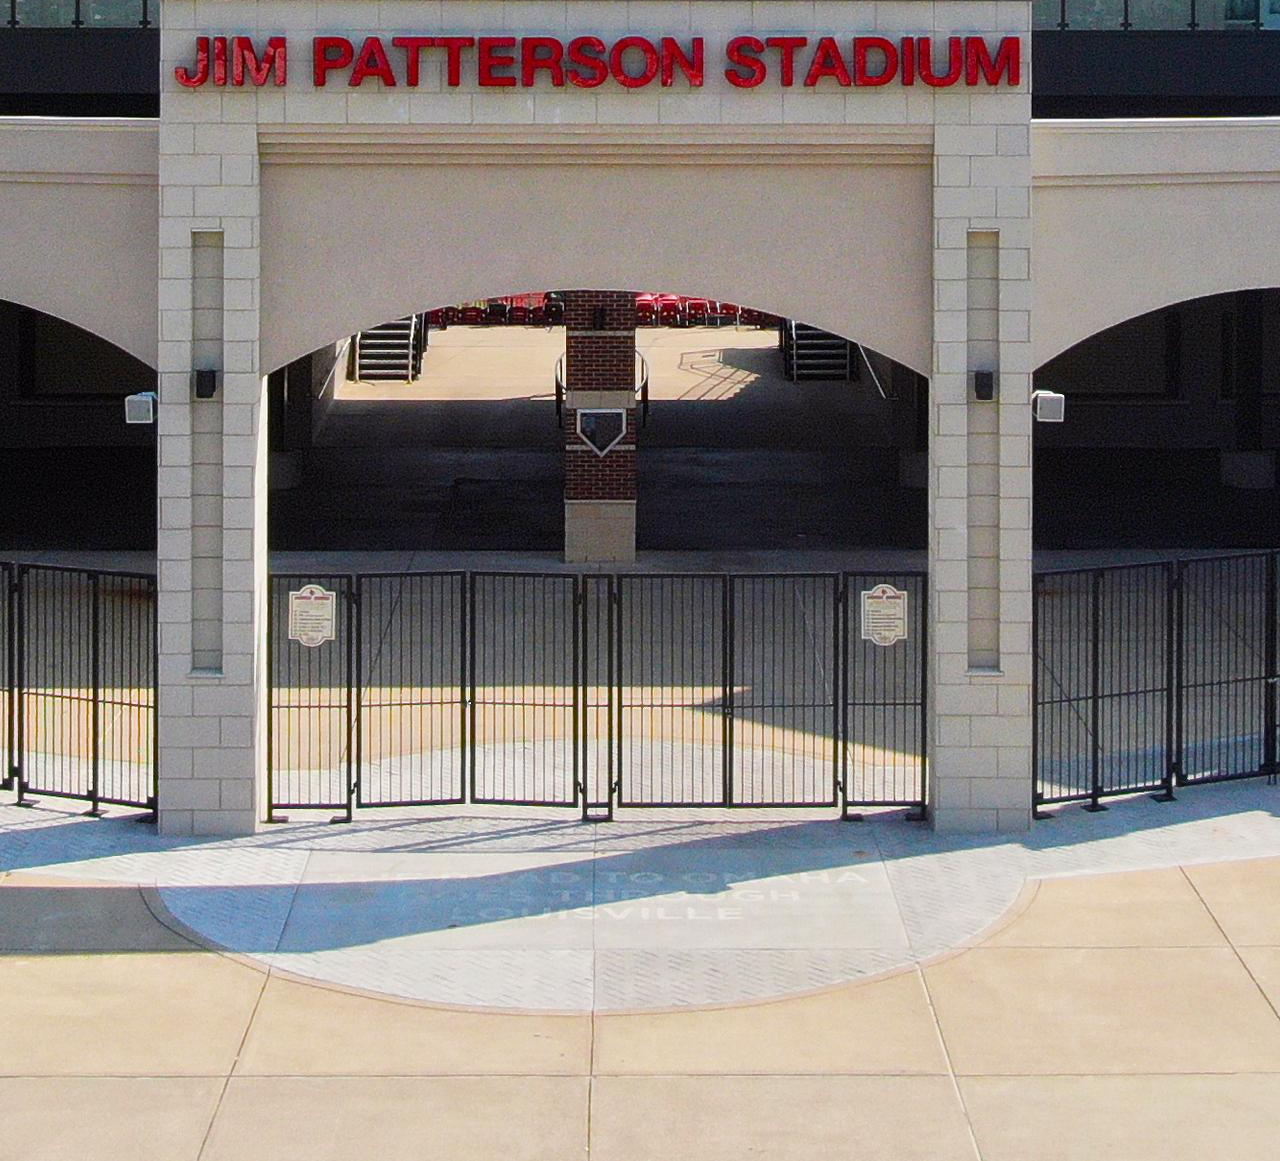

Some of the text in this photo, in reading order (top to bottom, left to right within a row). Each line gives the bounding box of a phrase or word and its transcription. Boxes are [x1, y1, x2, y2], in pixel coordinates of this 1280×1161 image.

[174, 35, 1021, 88] JIM PATTERSON STADIUM
[598, 871, 664, 884] TO
[682, 871, 867, 884] OMAHA
[552, 889, 801, 902] THROUGH
[452, 906, 744, 920] LOUISVILLE
